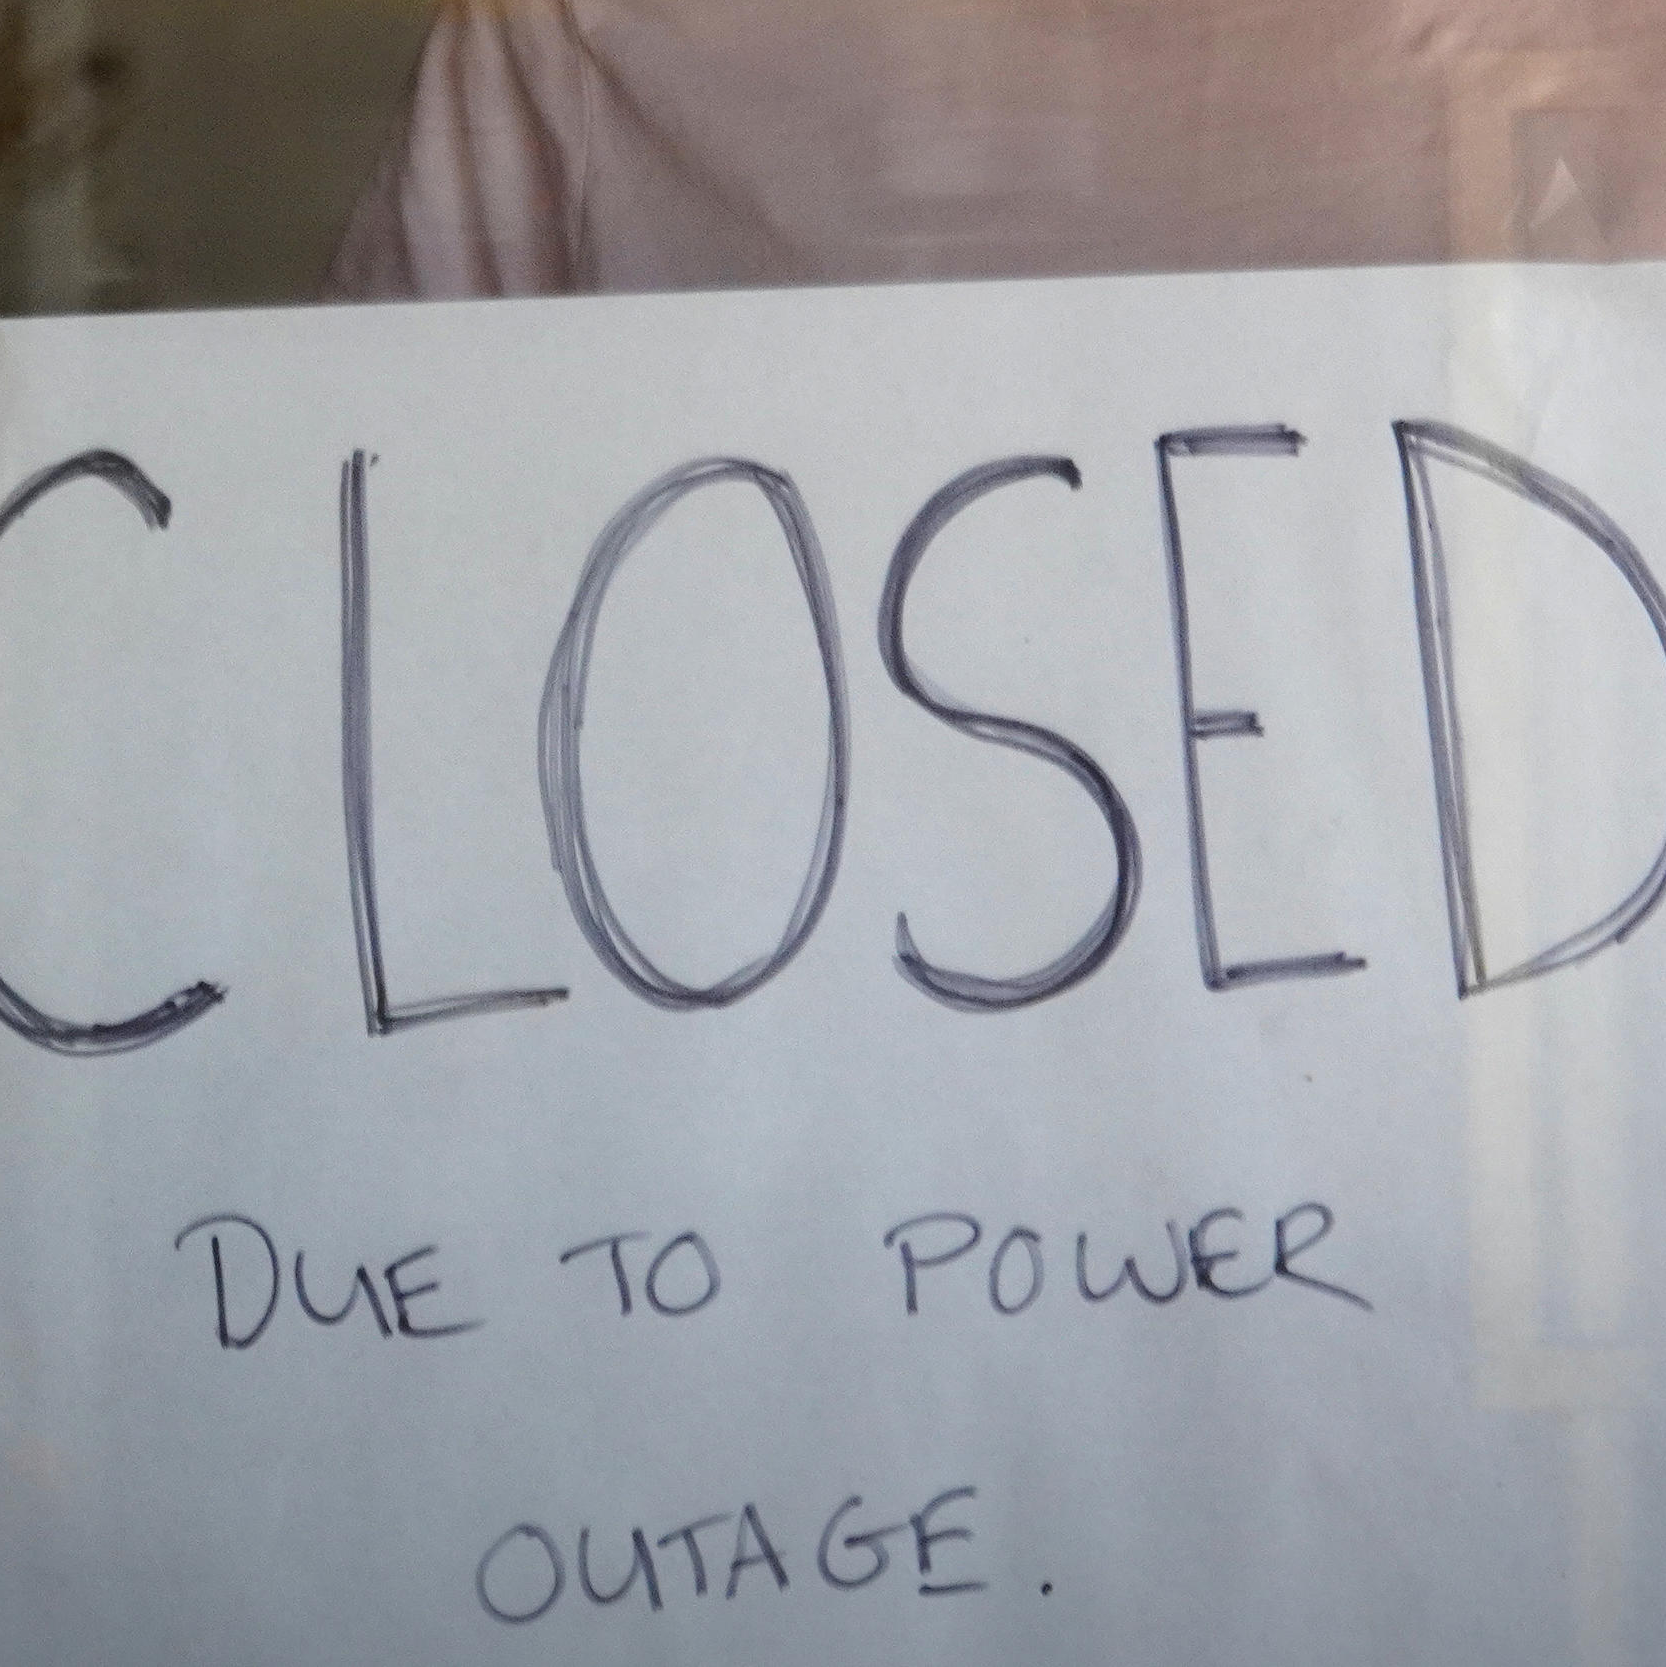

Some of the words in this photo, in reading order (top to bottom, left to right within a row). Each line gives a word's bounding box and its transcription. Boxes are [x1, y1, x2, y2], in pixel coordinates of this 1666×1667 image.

[173, 1213, 489, 1350] DUE
[558, 1229, 722, 1318] TO
[882, 1200, 1375, 1315] POWER
[473, 1485, 1056, 1627] OUTAGE.
